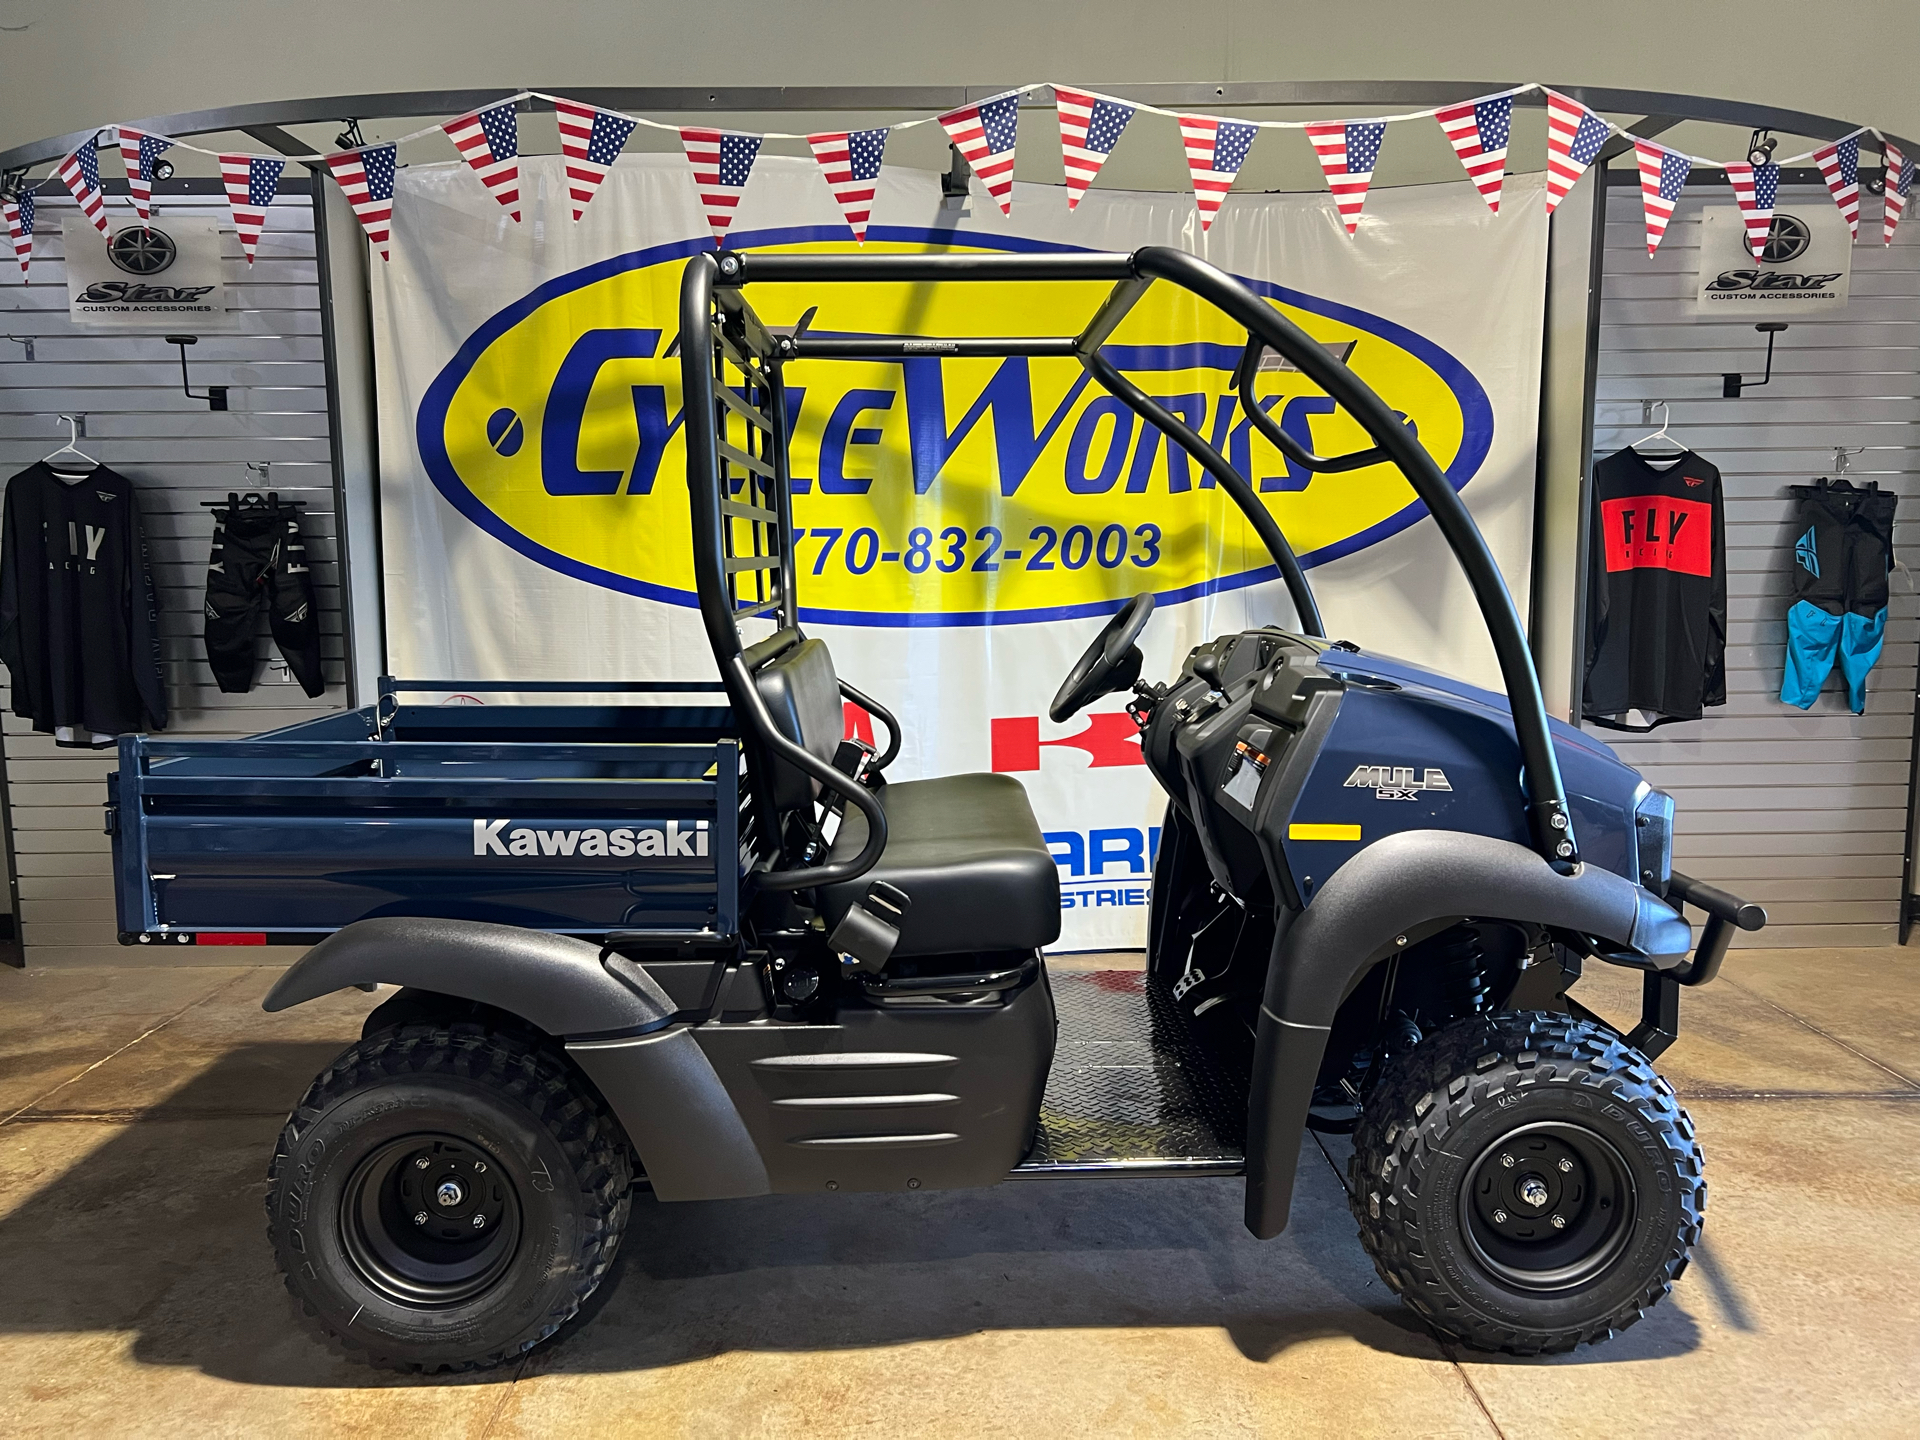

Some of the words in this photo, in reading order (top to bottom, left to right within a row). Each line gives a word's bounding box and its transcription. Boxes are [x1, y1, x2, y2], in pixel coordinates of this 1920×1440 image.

[1704, 269, 1844, 291] Star
[75, 281, 216, 303] Star
[1758, 292, 1836, 300] ACCESSORIES
[82, 305, 130, 313] CUSTOM
[132, 305, 212, 313] ACCESSORIES
[1621, 508, 1689, 546] FLY
[793, 522, 1162, 576] 70-832-2003
[1342, 765, 1454, 791] MULE
[1375, 788, 1419, 801] SX
[473, 818, 709, 857] Kawasaki
